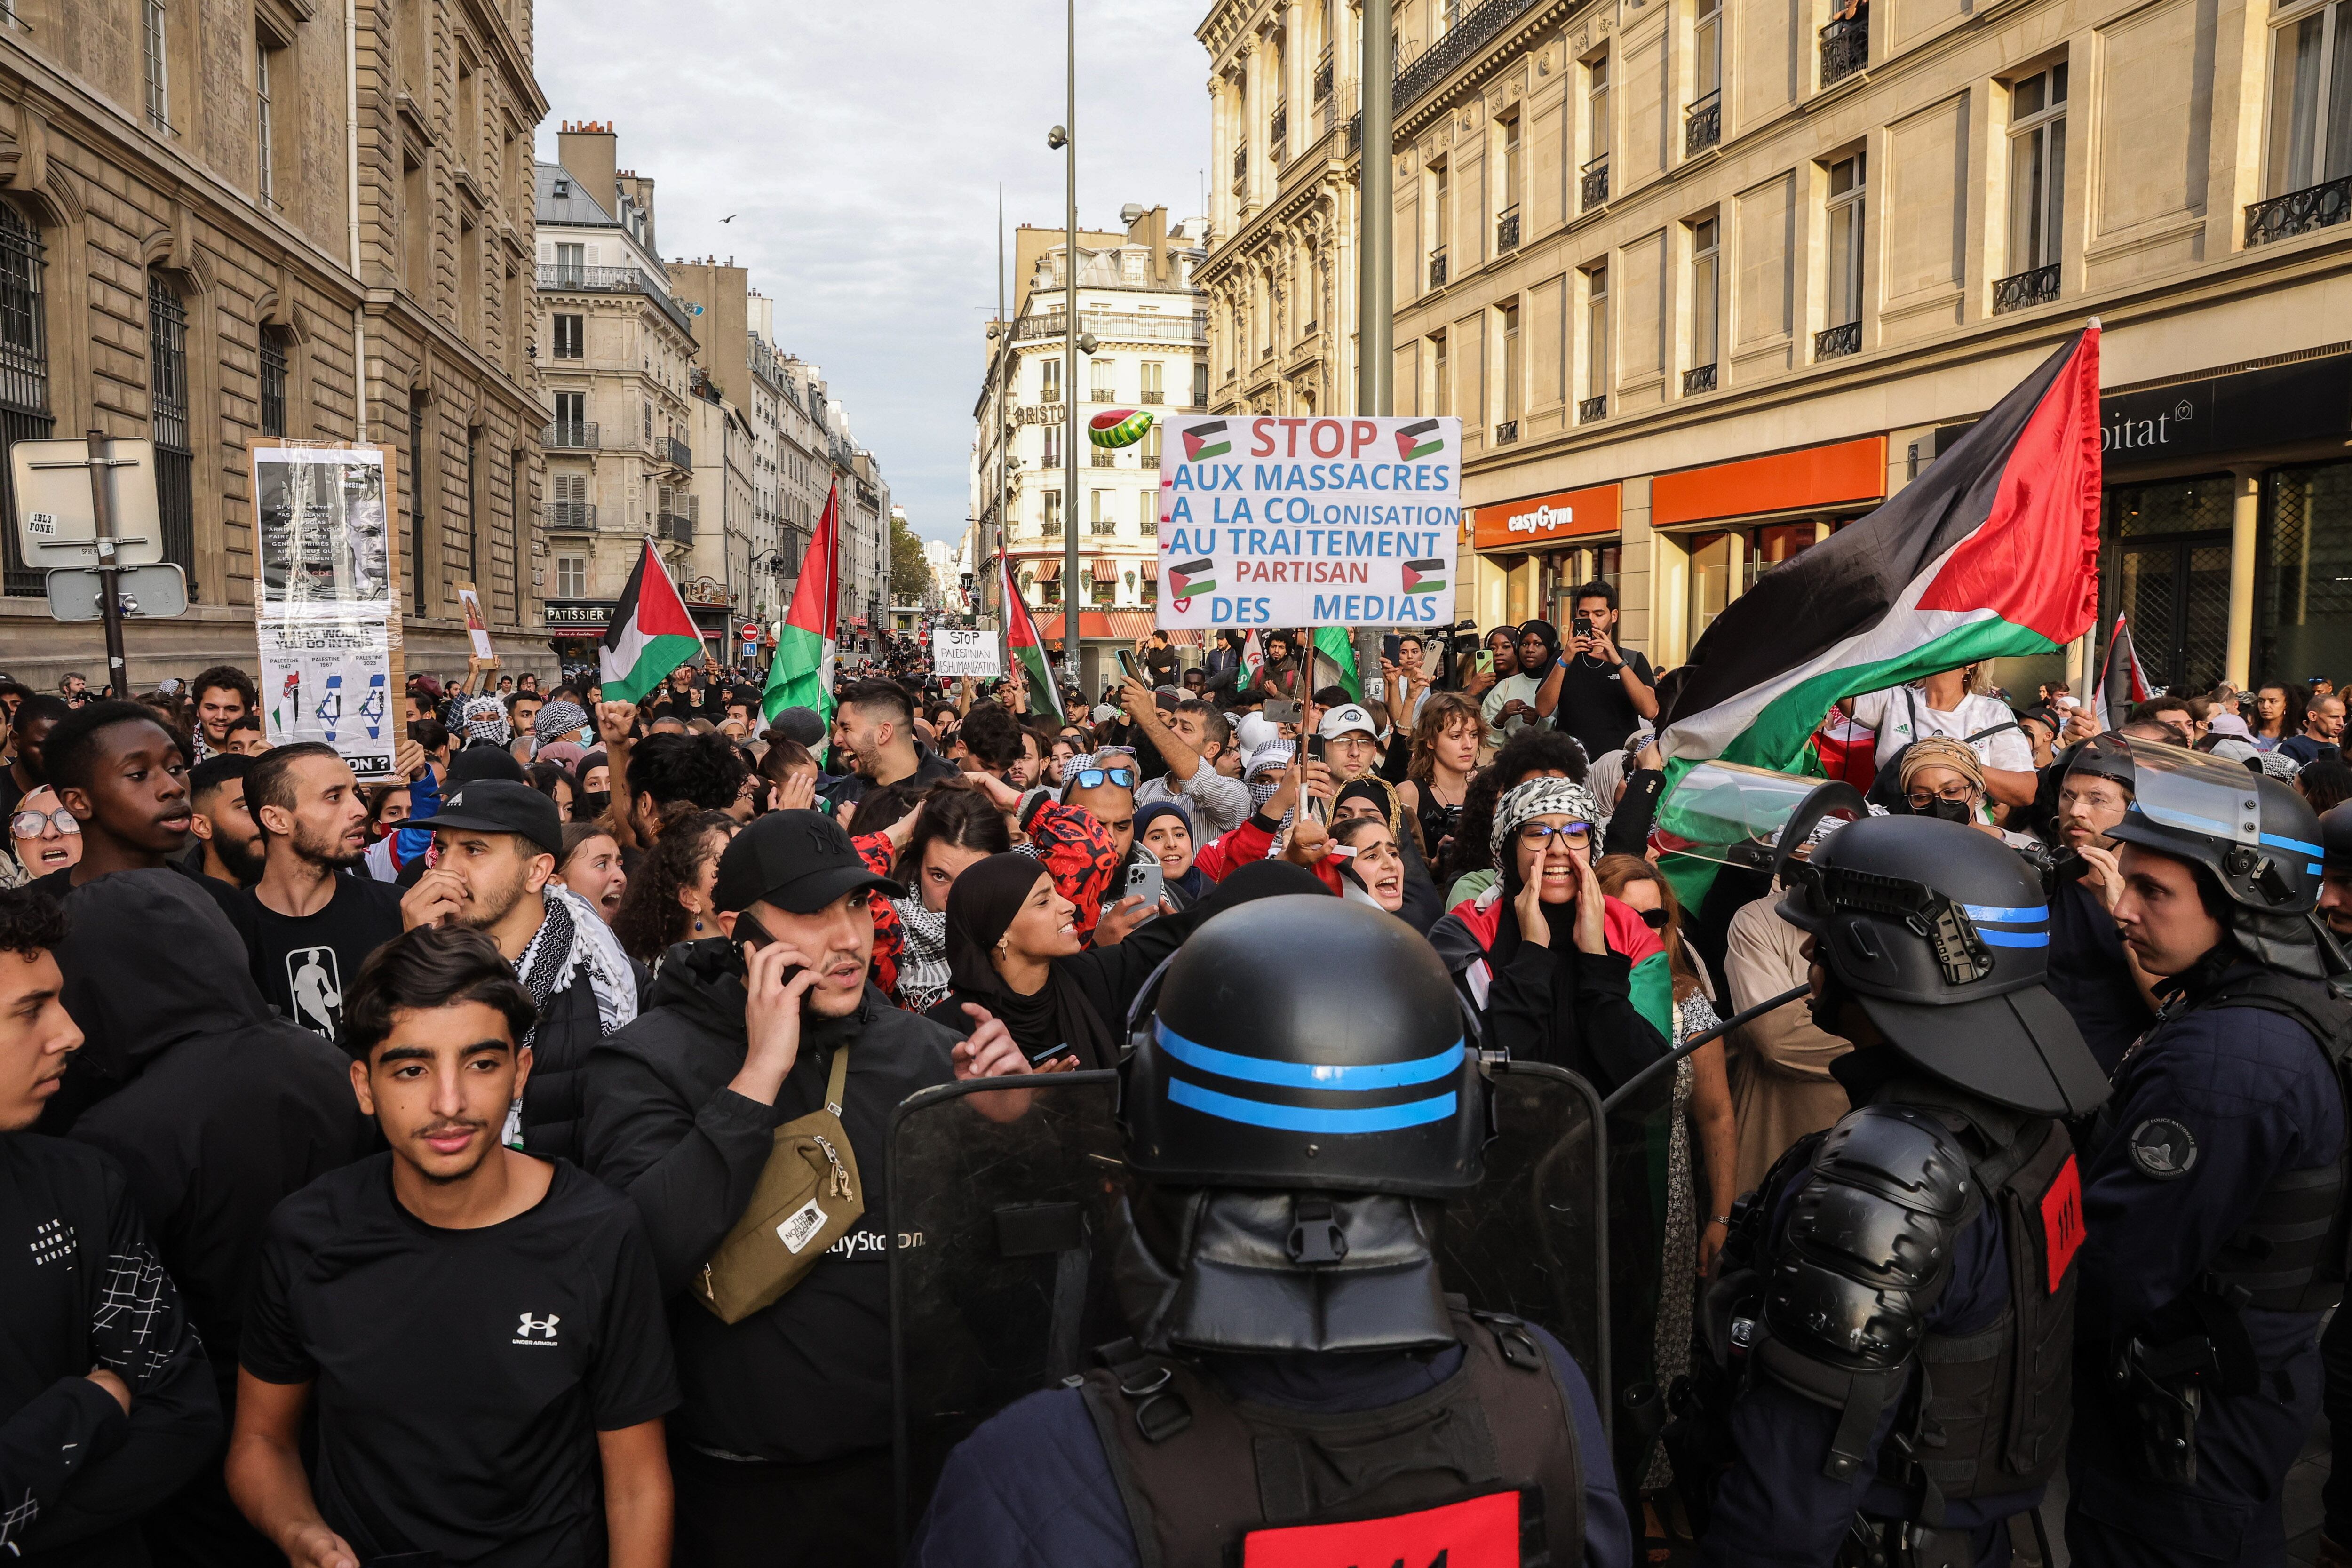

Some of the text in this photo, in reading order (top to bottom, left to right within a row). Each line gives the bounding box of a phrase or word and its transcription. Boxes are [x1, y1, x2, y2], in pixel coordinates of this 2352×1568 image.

[1251, 417, 1378, 459] STOP
[1172, 463, 1450, 491] AUX MASSACRES
[34, 513, 52, 523] 1BL3
[1170, 496, 1461, 526] A LA COLONISATION
[1508, 505, 1573, 533] easyGym
[1168, 528, 1441, 557] AU TRAITEMENT
[1236, 561, 1367, 583] PARTISAN
[548, 610, 604, 620] PATISSIER
[1211, 595, 1437, 623] DES MEDIAS
[306, 639, 325, 649] DO
[329, 639, 341, 648] IN
[950, 631, 980, 645] STOP
[377, 757, 388, 770] ?
[2171, 1121, 2195, 1145] NATIONALE
[785, 1218, 810, 1240] NORTH
[791, 1213, 806, 1226] THE
[795, 1223, 810, 1240] FACE
